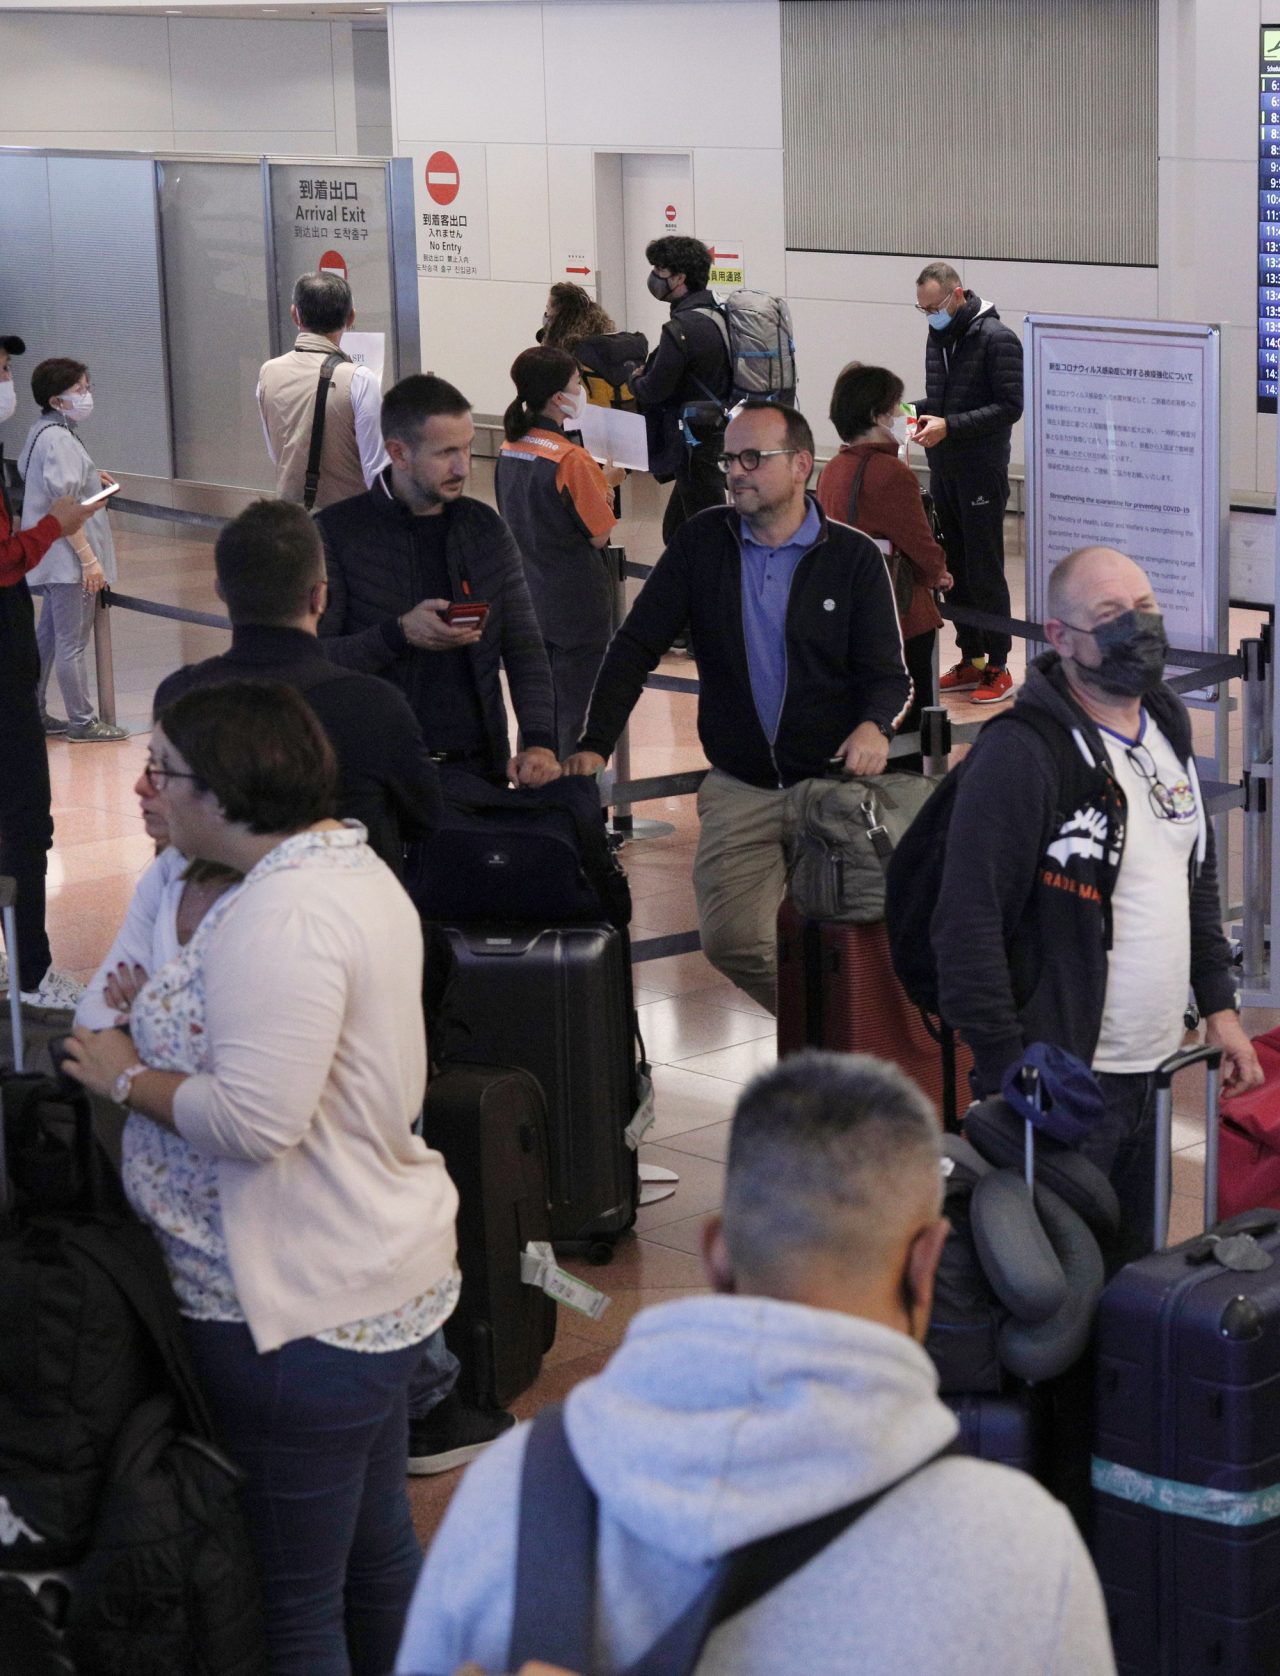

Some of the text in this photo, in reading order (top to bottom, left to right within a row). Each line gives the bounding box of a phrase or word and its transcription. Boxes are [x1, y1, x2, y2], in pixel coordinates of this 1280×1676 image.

[299, 180, 358, 201] 到着出口
[295, 205, 366, 223] Arrival Exit
[422, 213, 467, 227] 到着客出口
[429, 228, 463, 238] 入れません
[430, 241, 461, 254] No Entry
[1049, 492, 1085, 503] Strengthening
[1095, 498, 1124, 506] quarantine
[1133, 502, 1162, 512] preventing
[1162, 504, 1190, 513] COVID-19
